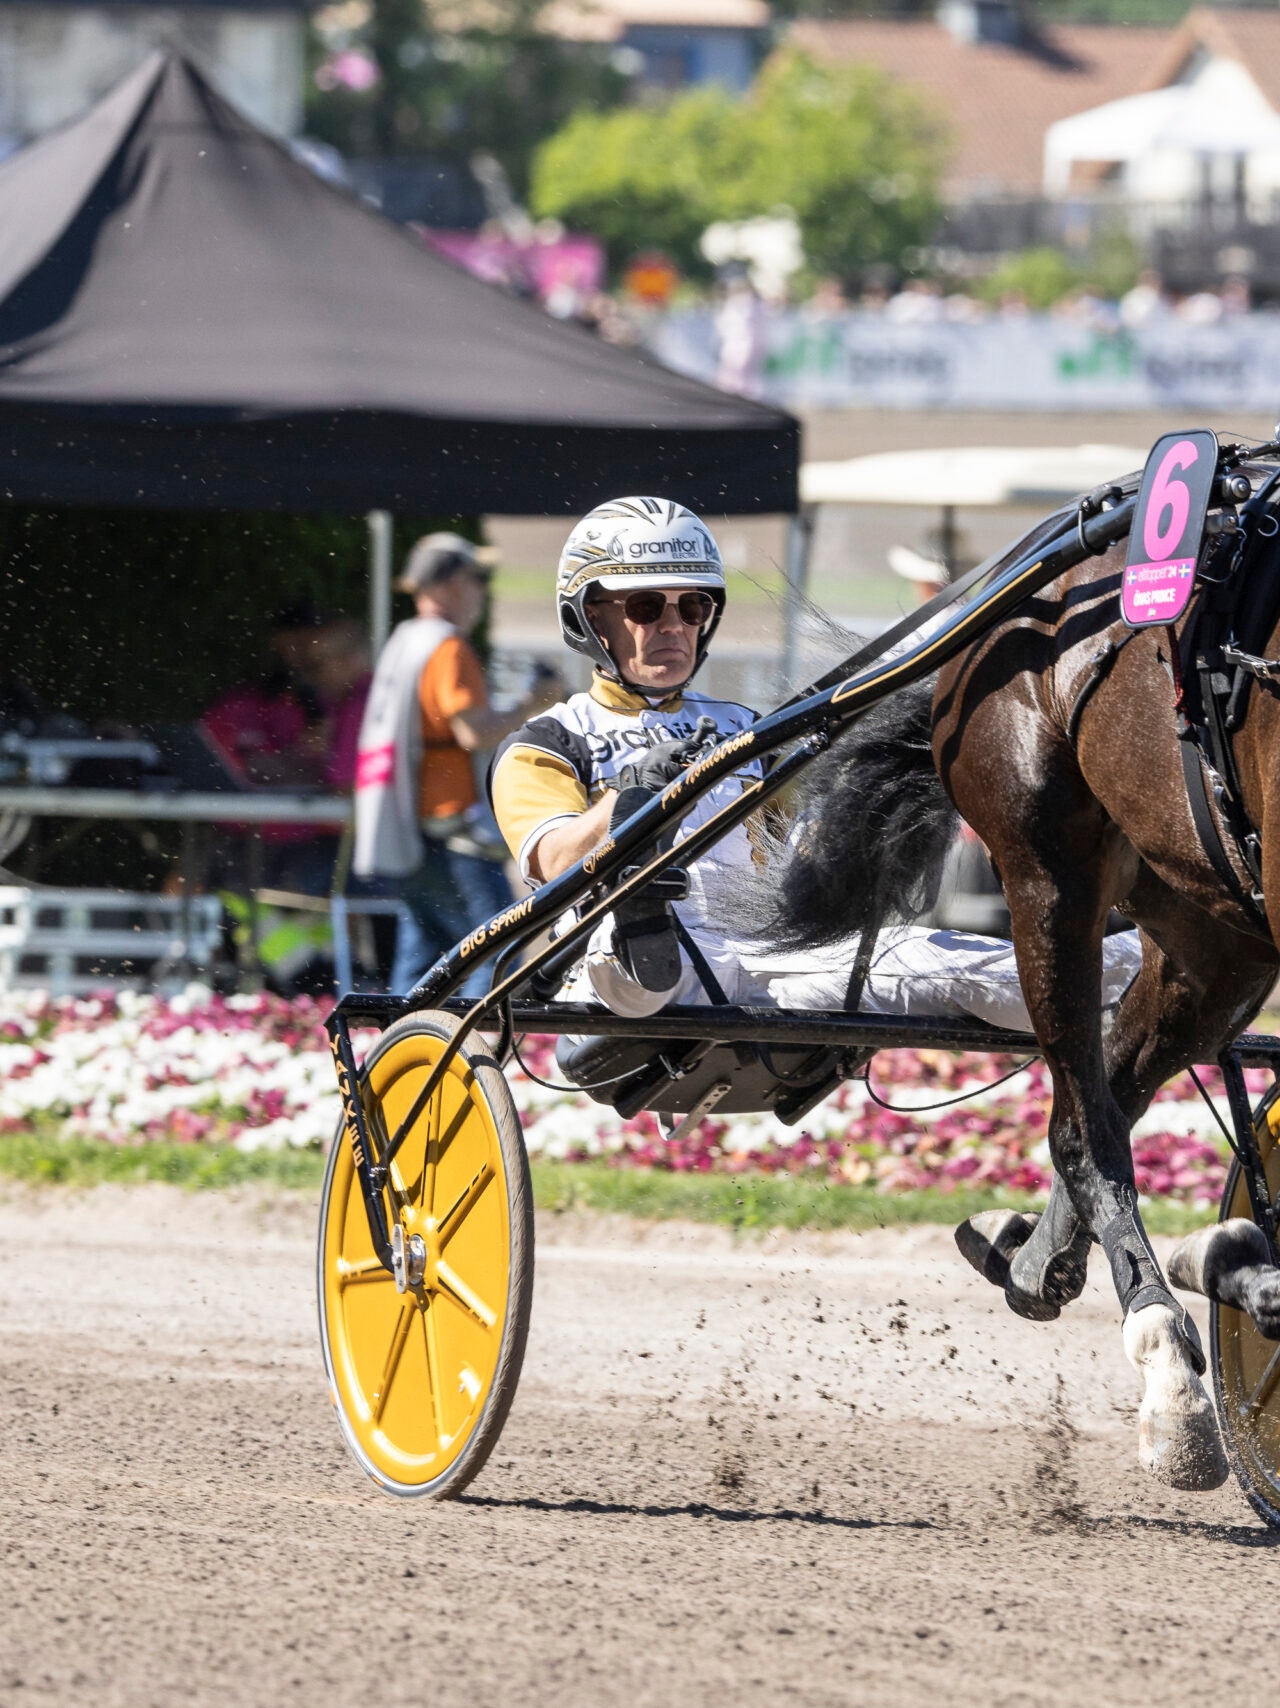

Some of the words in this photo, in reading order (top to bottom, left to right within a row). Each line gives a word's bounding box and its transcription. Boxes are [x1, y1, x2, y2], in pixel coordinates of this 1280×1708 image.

[1143, 440, 1199, 562] 6
[629, 537, 697, 558] granitor
[460, 924, 487, 958] BIG
[488, 896, 536, 937] SPRINT
[329, 1033, 365, 1169] YANKEE
